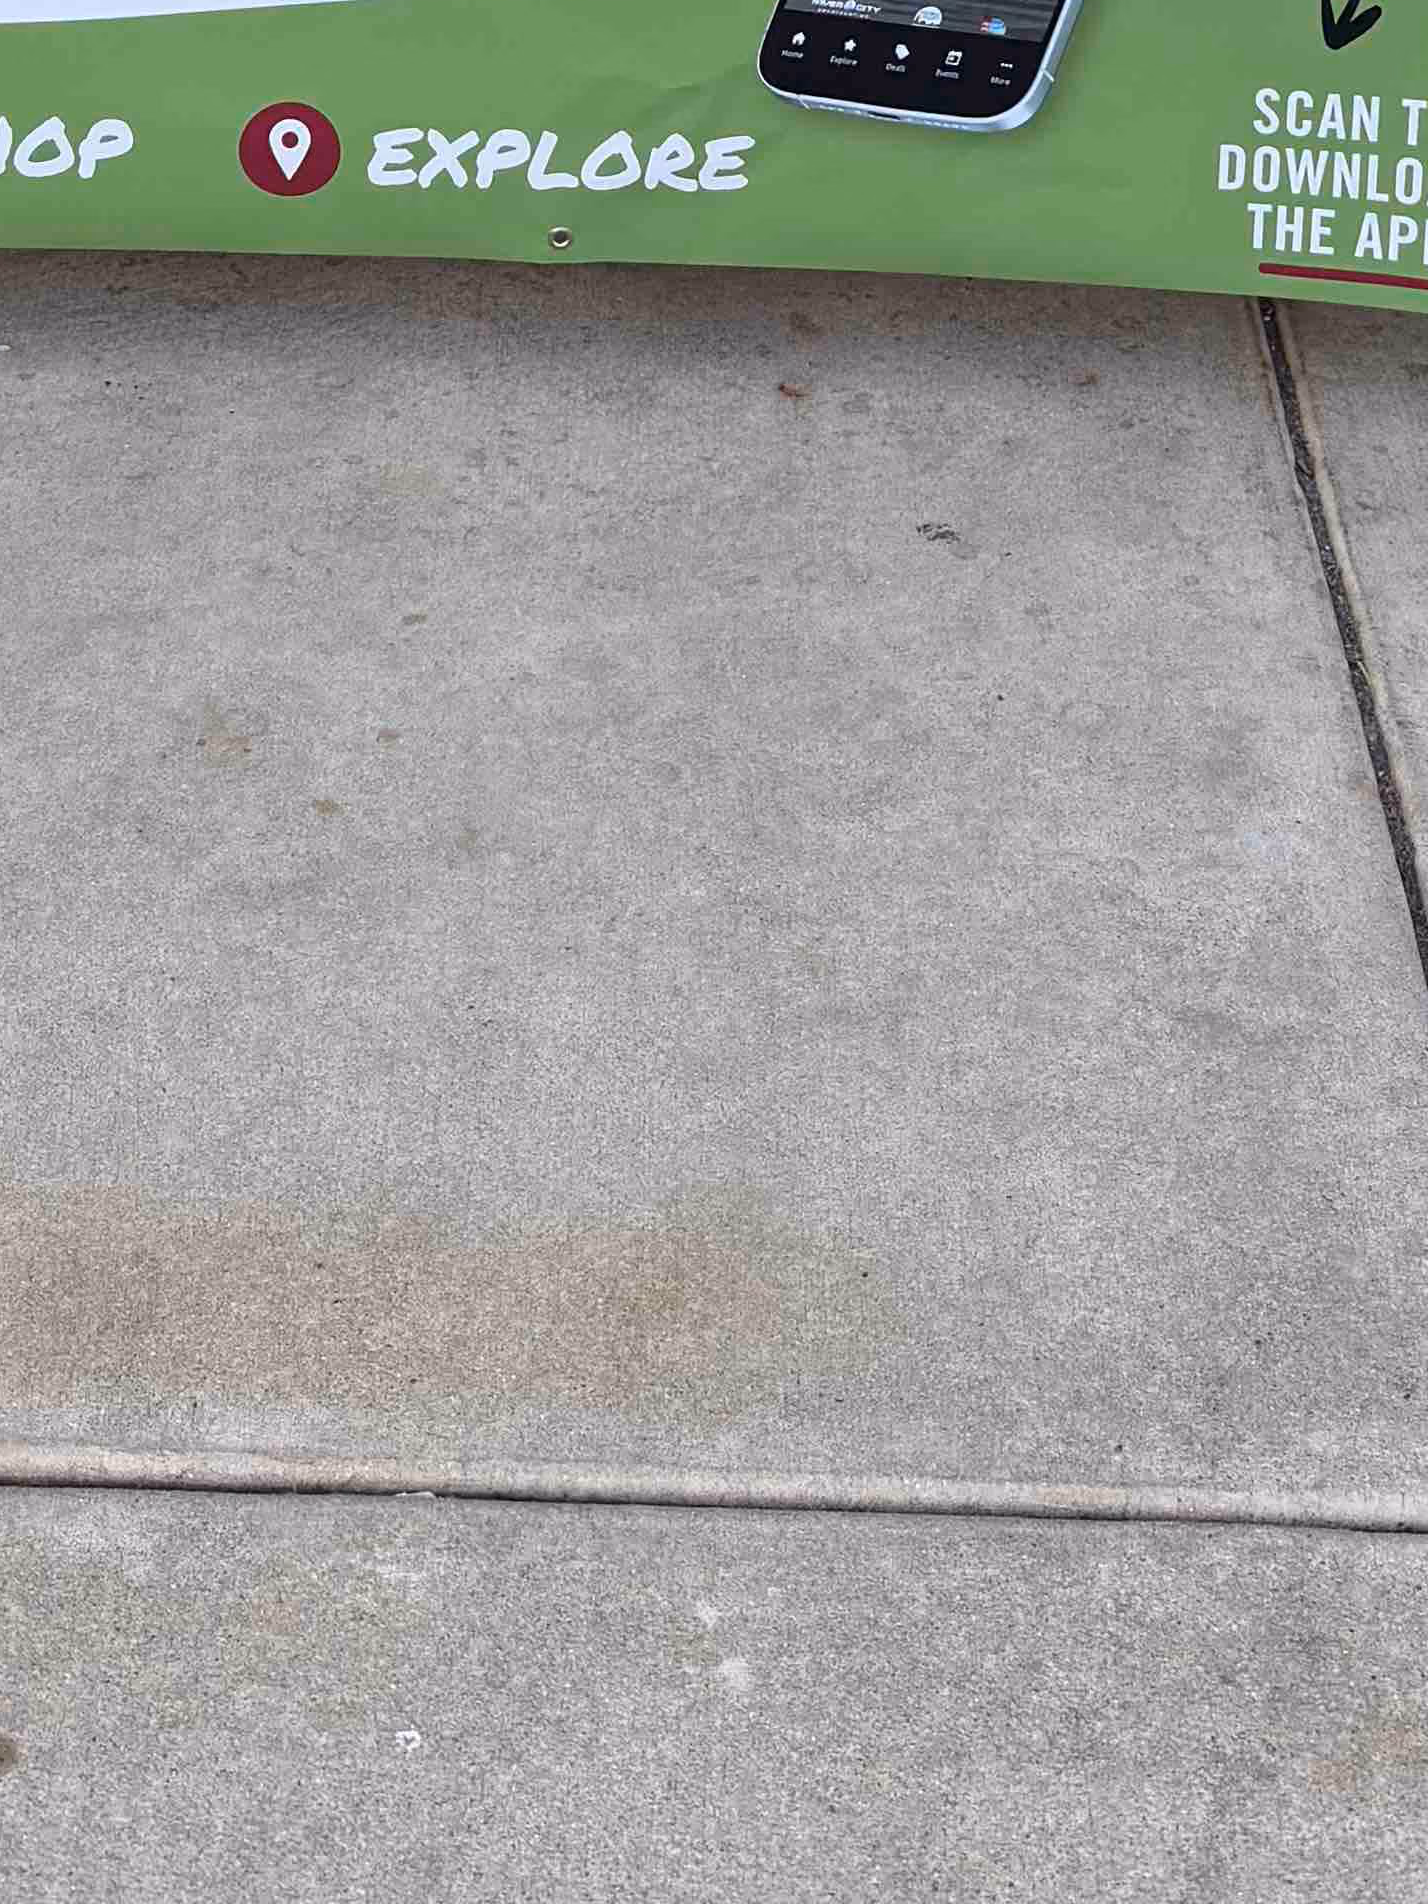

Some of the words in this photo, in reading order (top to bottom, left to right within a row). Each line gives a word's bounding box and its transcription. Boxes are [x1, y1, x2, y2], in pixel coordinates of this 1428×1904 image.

[781, 49, 804, 59] Home
[829, 55, 858, 67] Explore
[989, 75, 1011, 86] More
[1253, 88, 1381, 142] SCAN
[367, 127, 757, 192] EXPLORE
[1247, 203, 1336, 255] THE
